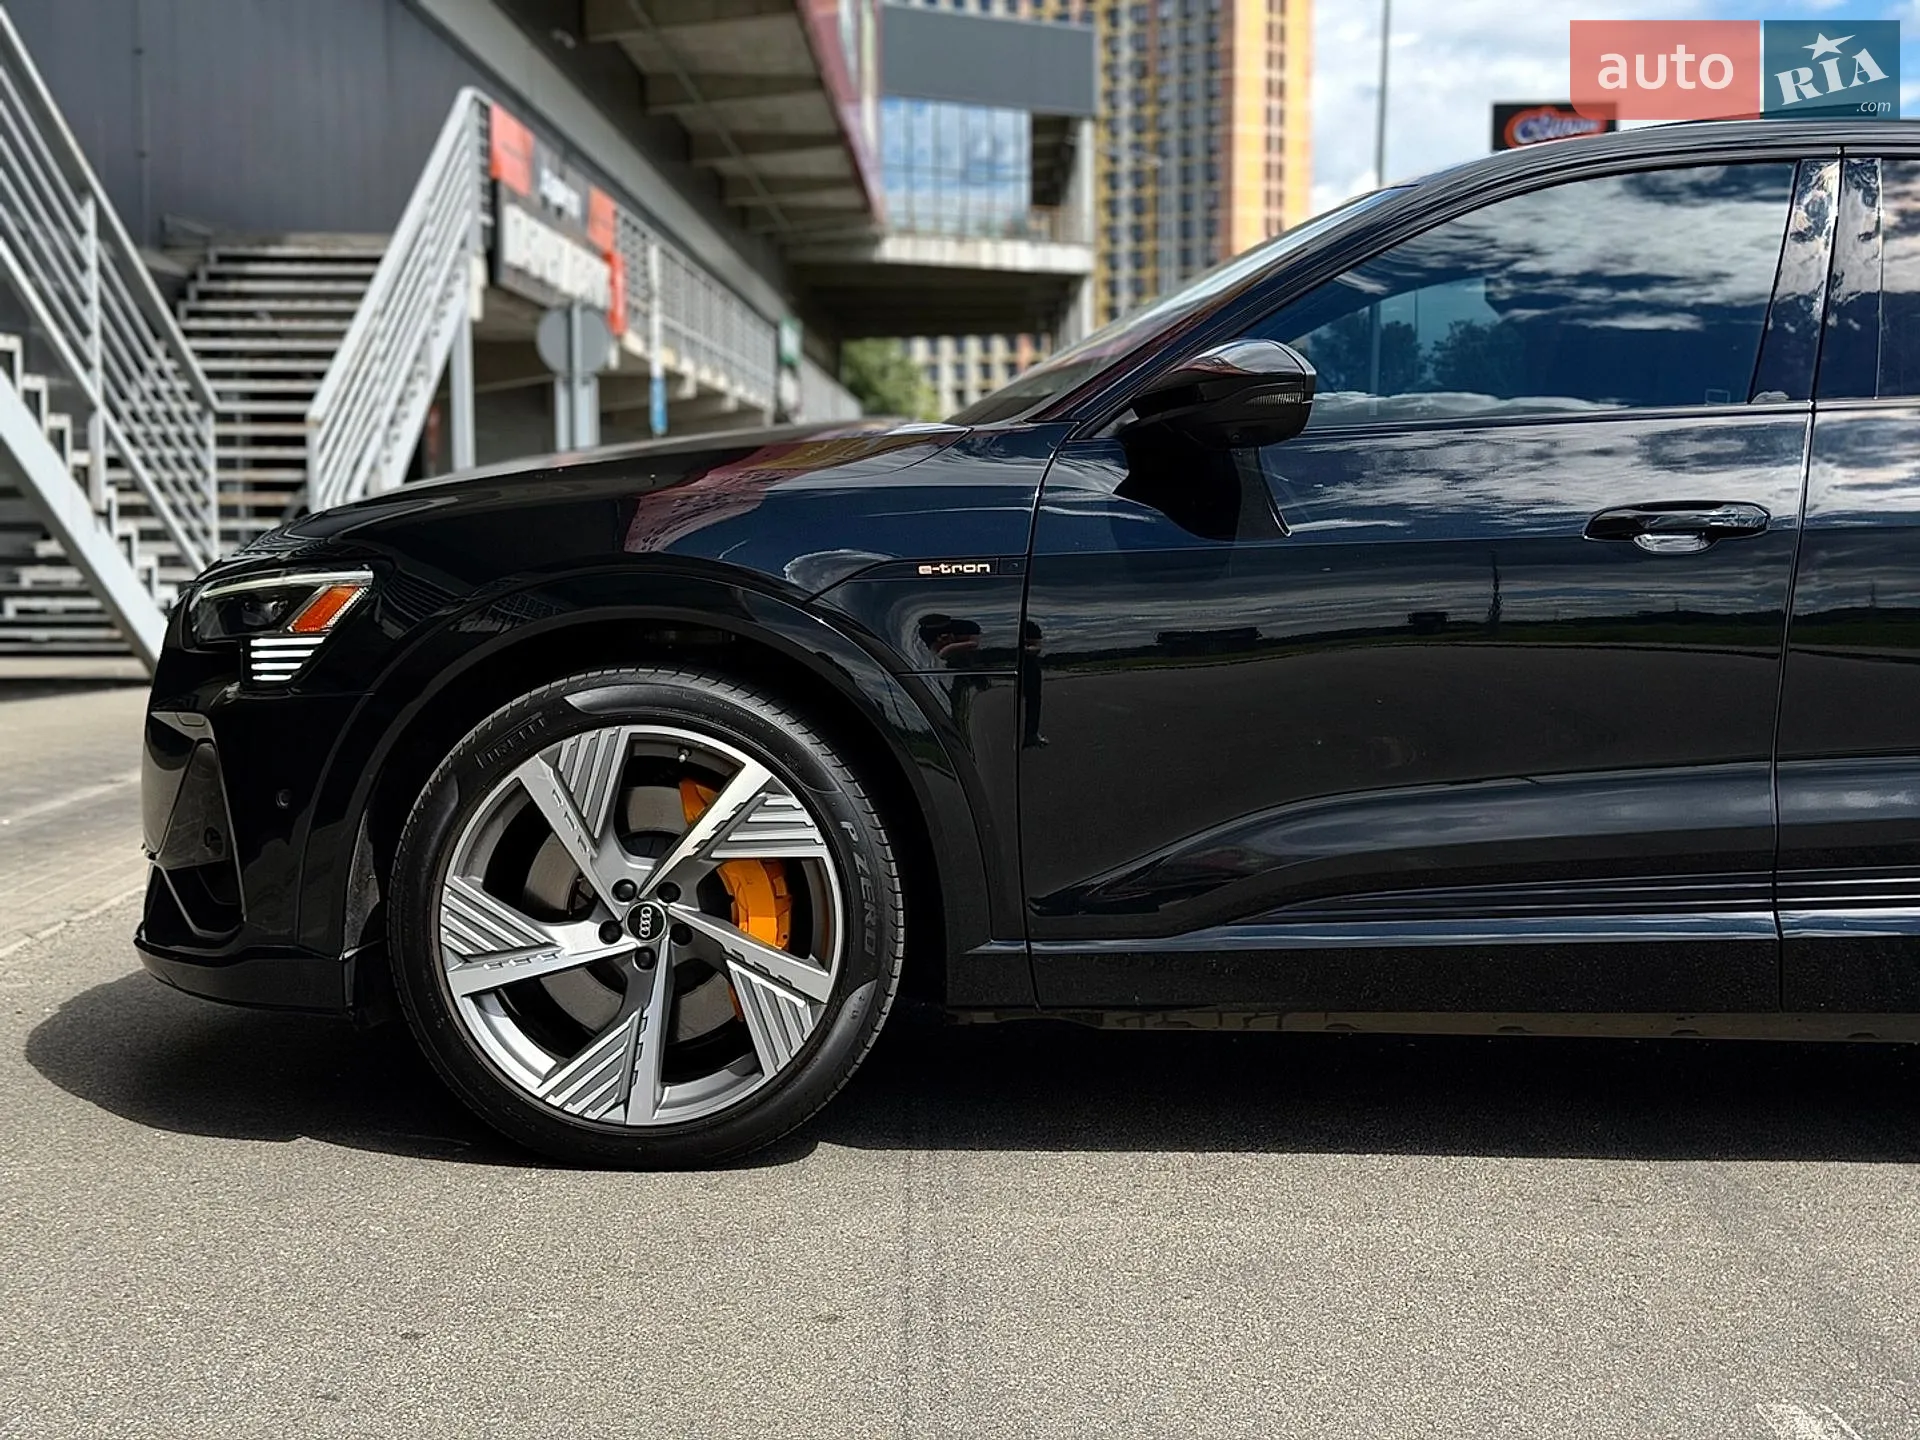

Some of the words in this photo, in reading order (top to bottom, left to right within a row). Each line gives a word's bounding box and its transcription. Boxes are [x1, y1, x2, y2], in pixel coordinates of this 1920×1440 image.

[918, 562, 991, 575] e-tron
[839, 821, 860, 843] P
[852, 851, 877, 956] ZERO
